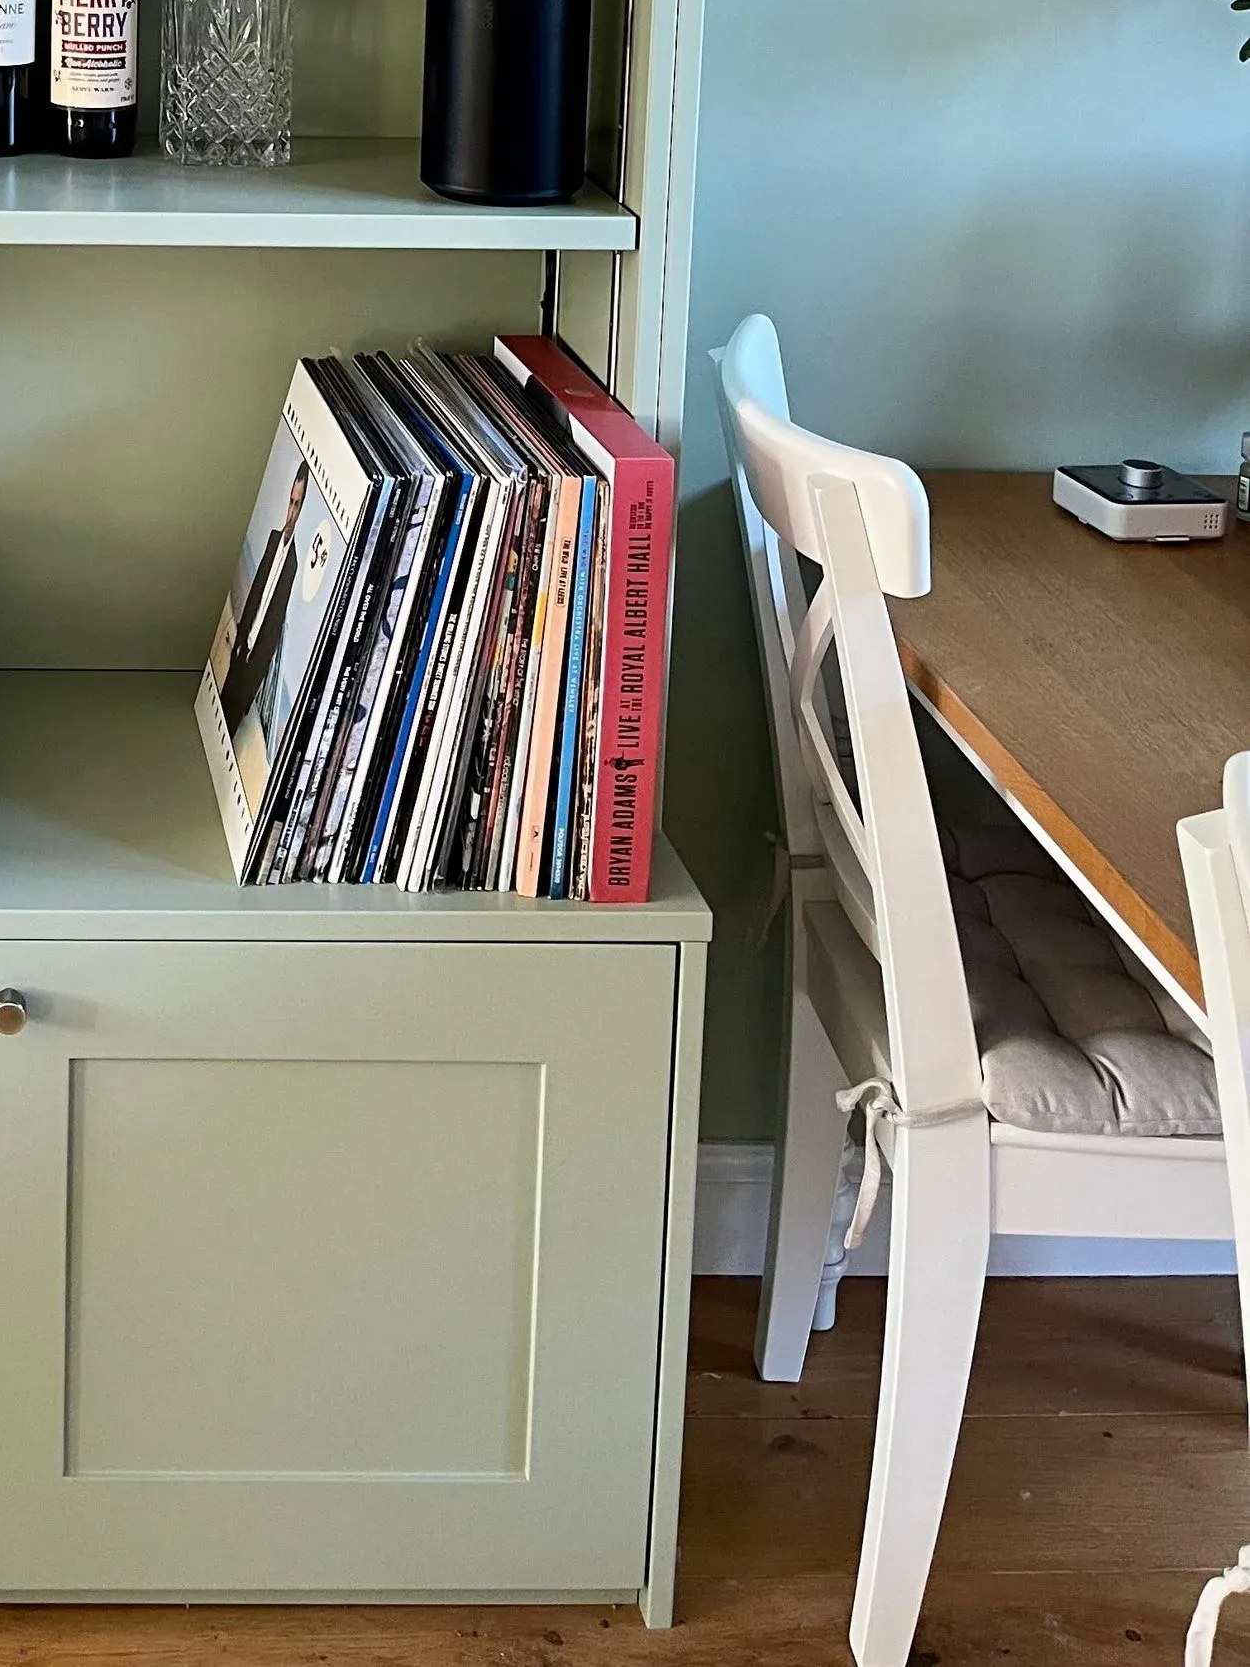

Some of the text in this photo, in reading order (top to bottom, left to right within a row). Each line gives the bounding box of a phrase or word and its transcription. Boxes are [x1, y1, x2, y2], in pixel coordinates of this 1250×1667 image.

[61, 12, 128, 37] BERRY
[64, 42, 123, 52] MULLED PUNCH
[563, 539, 571, 550] THE
[531, 543, 542, 571] THE WHO
[559, 567, 568, 580] LIVE
[578, 571, 586, 590] WITH
[363, 595, 371, 611] OVER
[573, 595, 584, 640] ORCHESTRA
[353, 621, 364, 643] WORLD
[443, 623, 455, 644] ROLLING
[439, 643, 450, 662] STONES
[521, 638, 529, 650] THE
[571, 644, 580, 660] LIVE
[517, 650, 526, 667] STORY
[516, 667, 524, 676] OF
[567, 677, 577, 713] WEMBLEY
[608, 533, 651, 887] BRYAN ADAMS LIVE AT THE ROYAL ALBERT HALL
